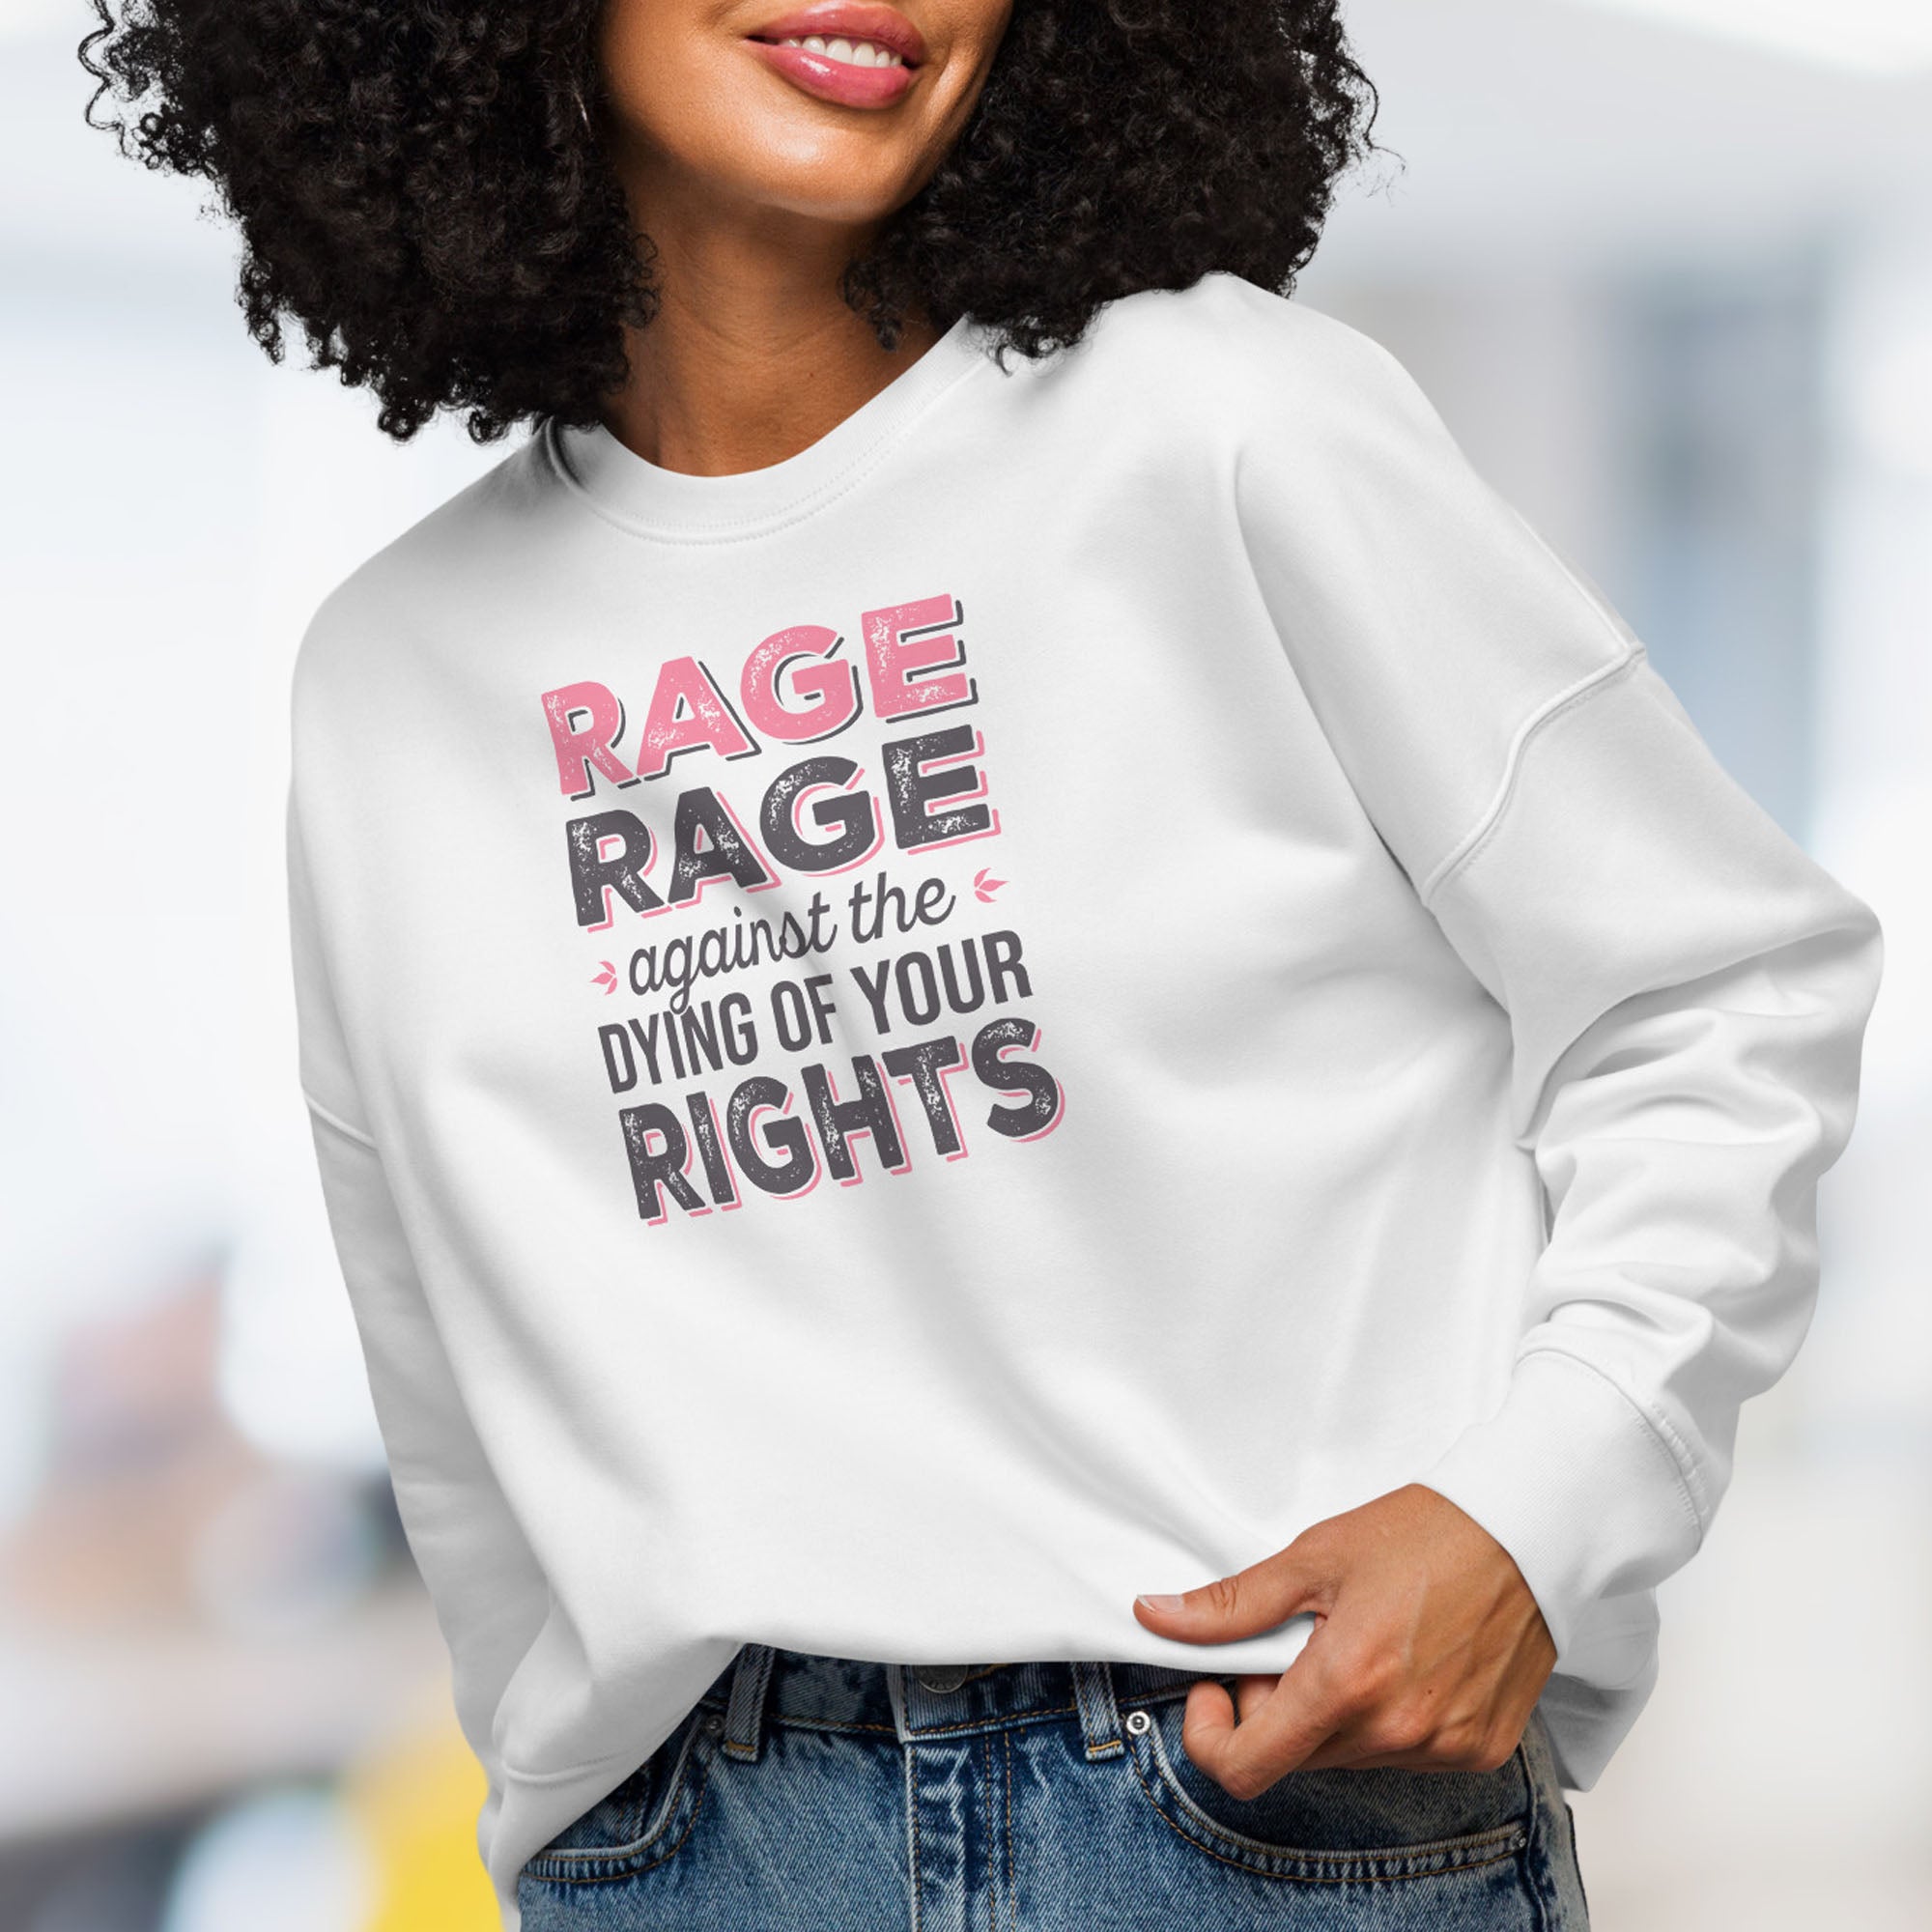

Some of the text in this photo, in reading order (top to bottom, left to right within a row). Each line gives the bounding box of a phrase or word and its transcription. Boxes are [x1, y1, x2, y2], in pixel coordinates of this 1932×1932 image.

[541, 593, 979, 801] RAGE
[565, 724, 1001, 933] RAGE
[598, 929, 1033, 1094] DYING OF YOUR
[628, 871, 956, 1014] against the
[618, 1016, 1065, 1226] RIGHTS
